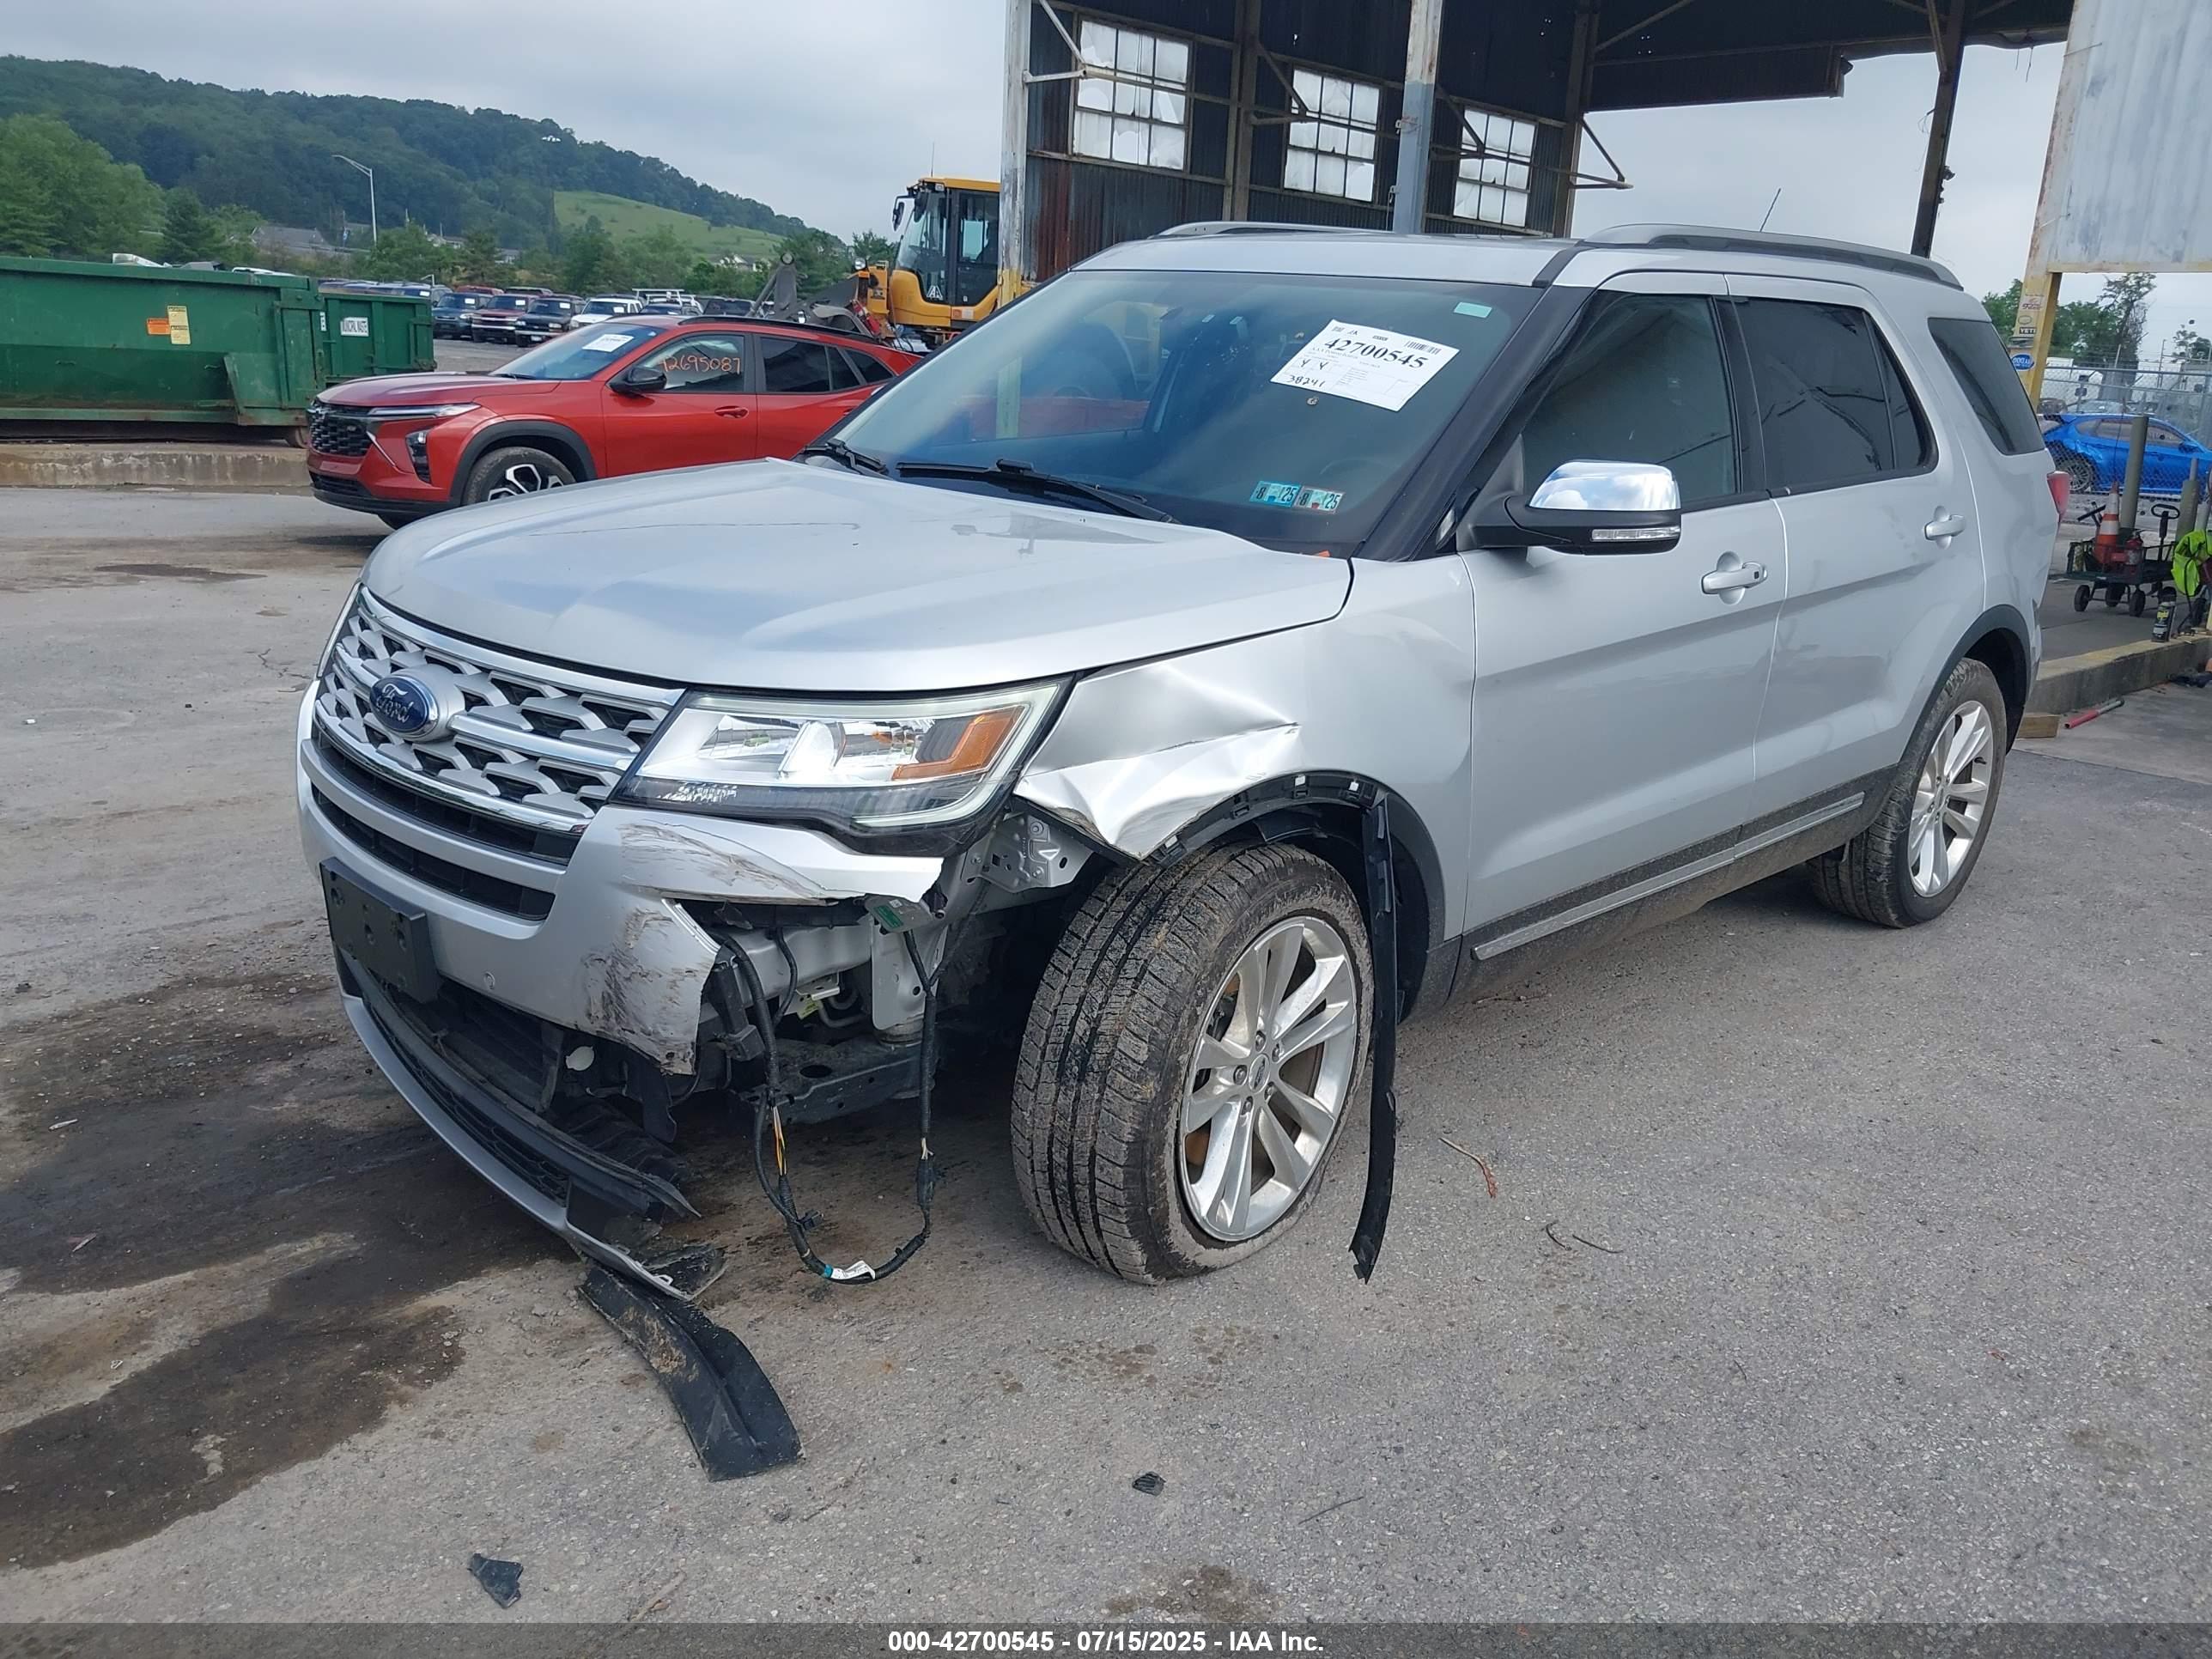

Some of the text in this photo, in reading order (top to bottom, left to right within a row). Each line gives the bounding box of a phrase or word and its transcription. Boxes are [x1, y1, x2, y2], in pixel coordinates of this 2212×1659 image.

[1324, 337, 1429, 368] 42700545
[1287, 374, 1326, 388] 38241
[1282, 487, 1297, 502] 25
[1325, 493, 1340, 509] 25
[376, 683, 415, 723] Ford
